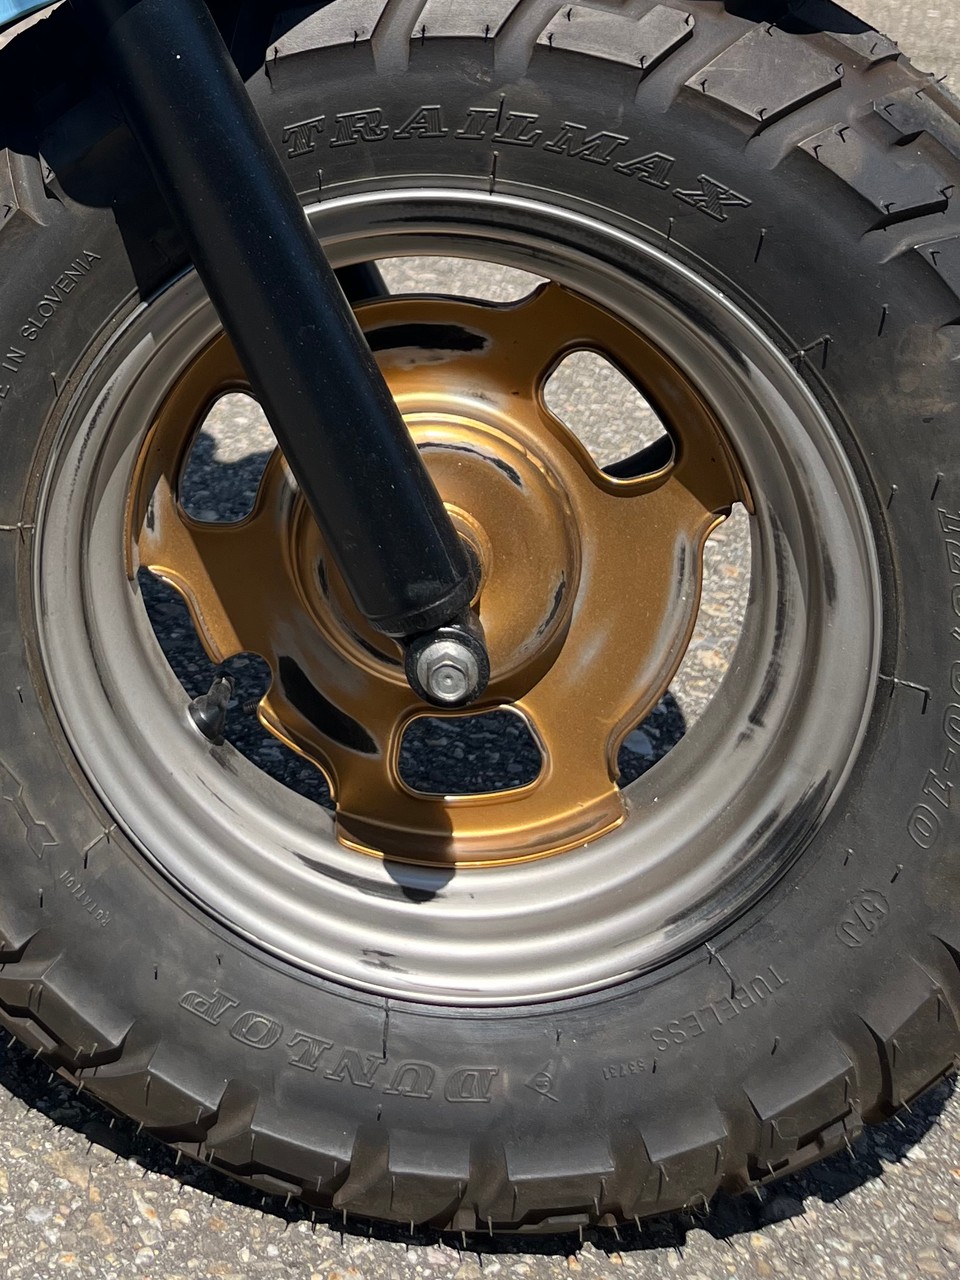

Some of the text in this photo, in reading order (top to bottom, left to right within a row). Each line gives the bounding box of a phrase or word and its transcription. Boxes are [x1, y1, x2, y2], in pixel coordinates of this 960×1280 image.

[283, 105, 752, 222] TRAILMAX
[2, 346, 27, 373] IN
[20, 249, 102, 341] SLOVENIA
[57, 869, 112, 927] ROTATION
[178, 987, 500, 1103] DUNLOP
[648, 964, 790, 1052] TUBELESS
